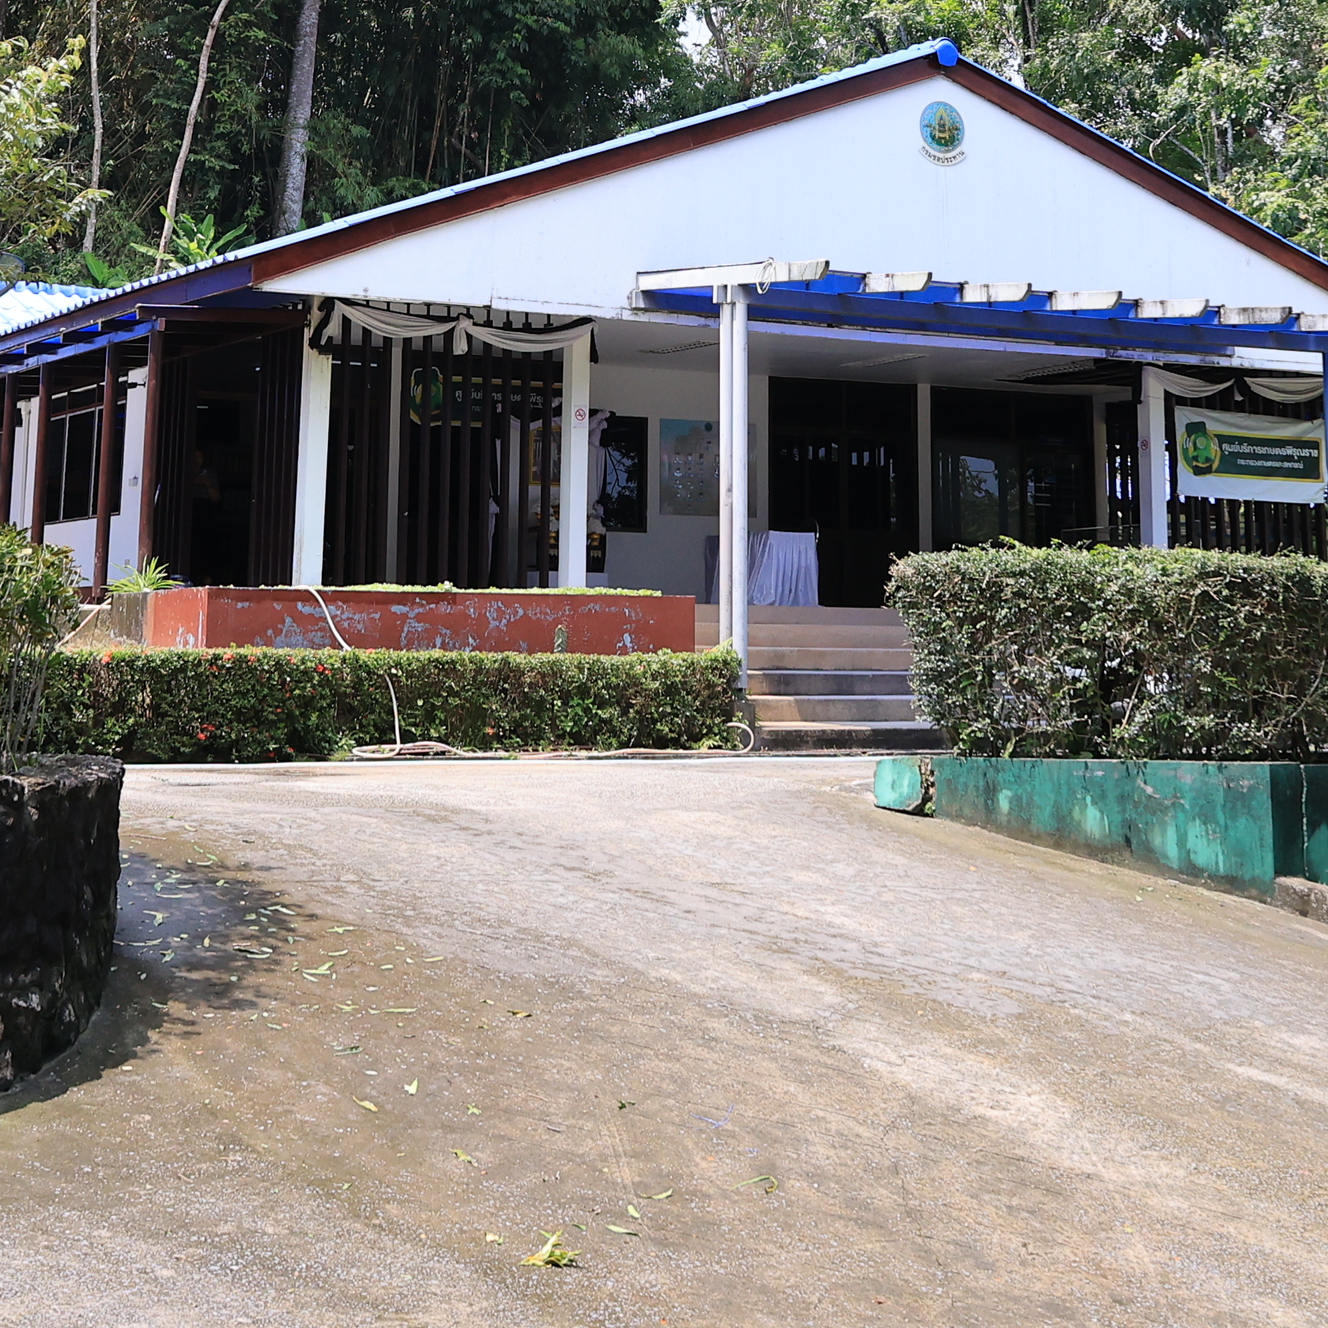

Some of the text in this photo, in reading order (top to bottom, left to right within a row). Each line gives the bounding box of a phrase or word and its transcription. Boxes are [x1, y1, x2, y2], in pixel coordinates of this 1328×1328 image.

[920, 145, 965, 164] กรมชลประทาน
[1221, 441, 1319, 460] ศูนย์บริการเกษตรพิรุณราช
